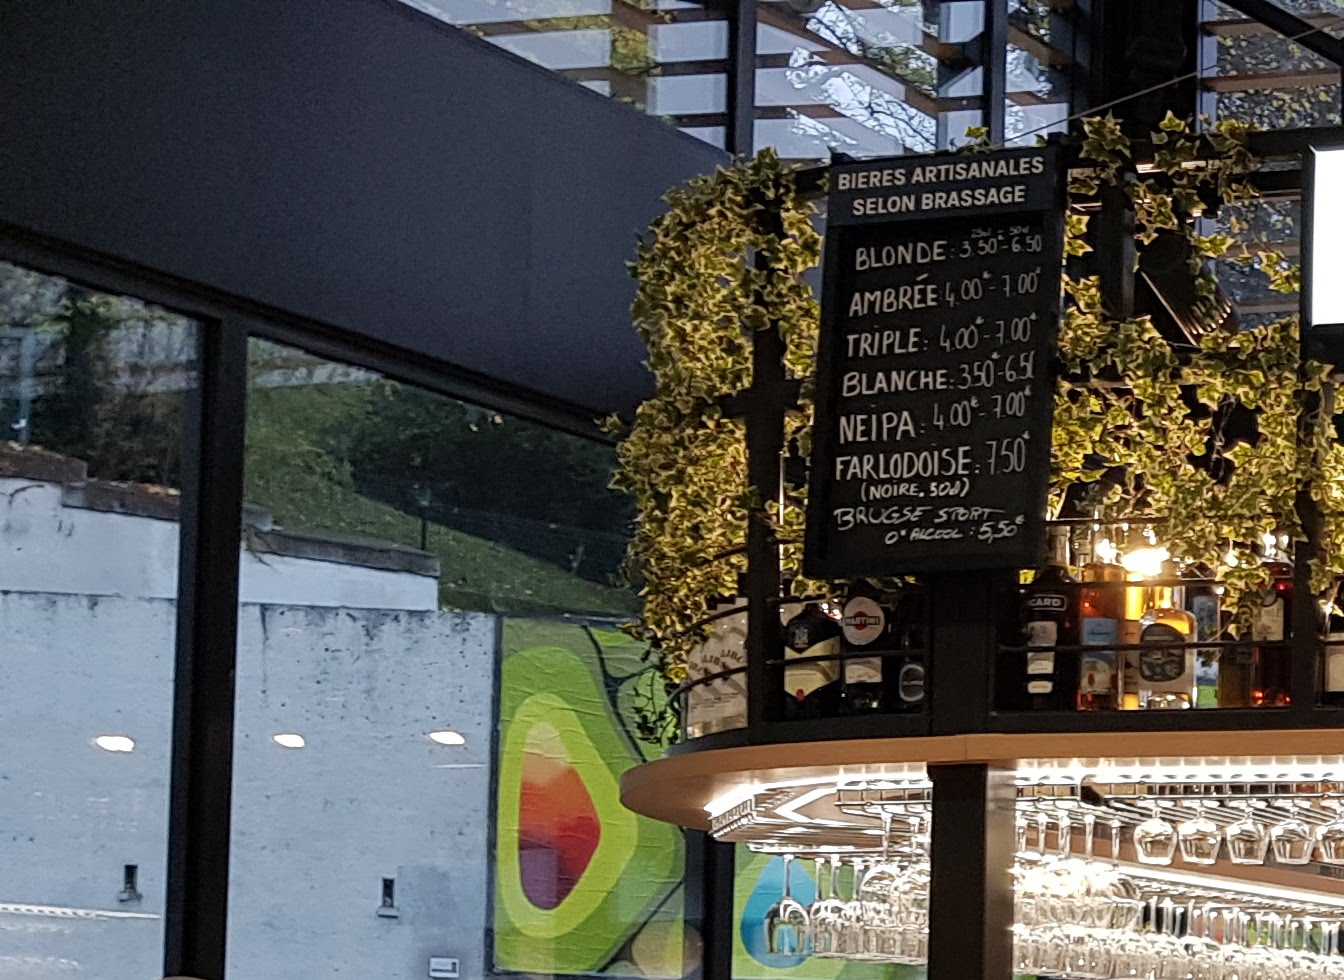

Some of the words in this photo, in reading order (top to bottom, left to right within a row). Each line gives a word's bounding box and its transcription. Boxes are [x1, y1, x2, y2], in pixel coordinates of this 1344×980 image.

[838, 169, 906, 190] BIERES
[911, 157, 1045, 184] ARTISANALES
[852, 194, 915, 216] SELON
[921, 185, 1026, 210] BRASSAGE
